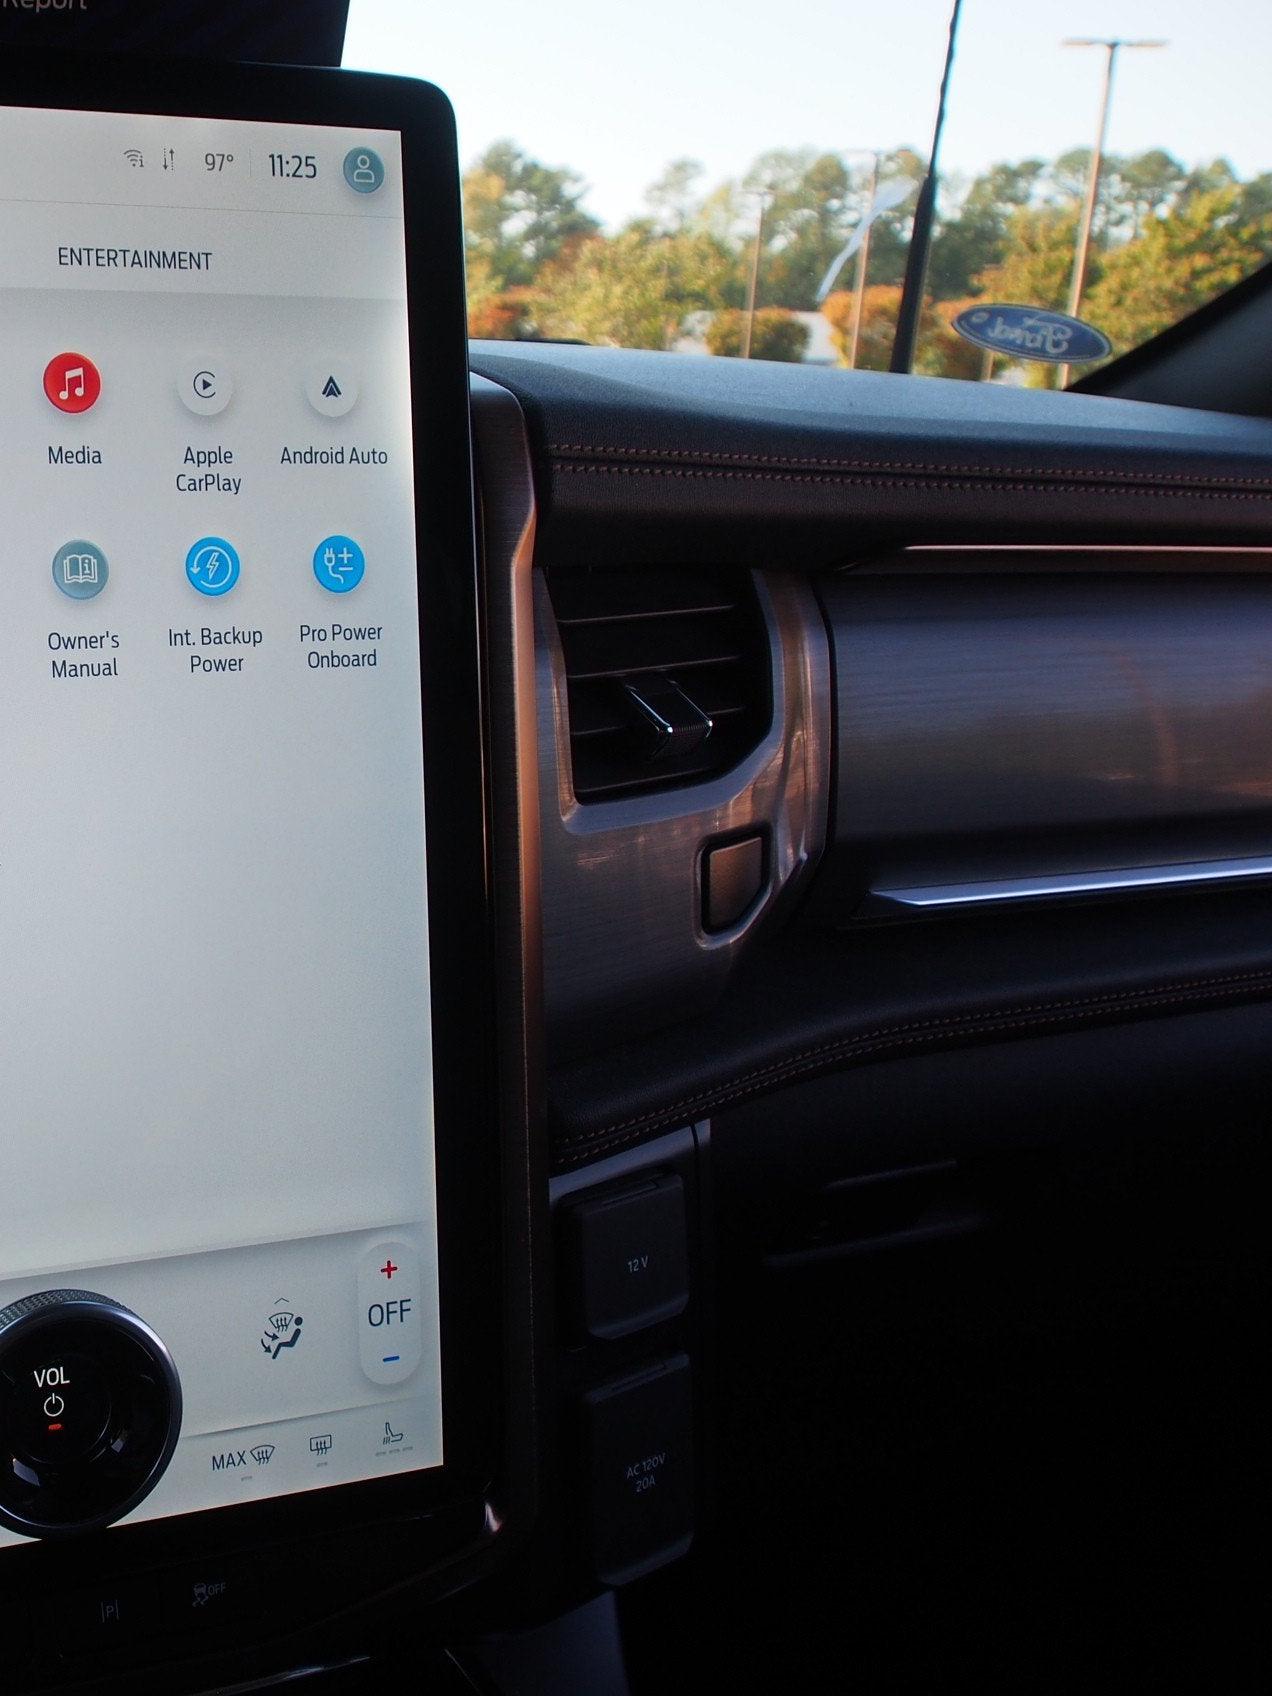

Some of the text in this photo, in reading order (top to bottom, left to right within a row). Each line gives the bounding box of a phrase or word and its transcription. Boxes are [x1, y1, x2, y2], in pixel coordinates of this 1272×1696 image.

[204, 152, 234, 172] 97°
[268, 153, 318, 179] 11:25
[57, 246, 213, 272] ENTERTAINMENT
[48, 445, 103, 466] Media
[183, 445, 234, 469] Apple
[280, 445, 389, 466] Android Auto
[176, 472, 242, 496] CarPlay
[47, 630, 120, 652] Owner's
[168, 625, 263, 649] Int. Backup
[299, 622, 383, 643] Pro Power
[51, 657, 119, 680] Manual
[190, 655, 244, 675] Power
[307, 648, 378, 671] Onboard
[628, 1256, 649, 1273] 12 V
[367, 1298, 413, 1328] OFF
[32, 1367, 71, 1388] VOL
[211, 1449, 248, 1471] MAX
[626, 1463, 641, 1480] AC
[207, 1581, 227, 1597] OFF
